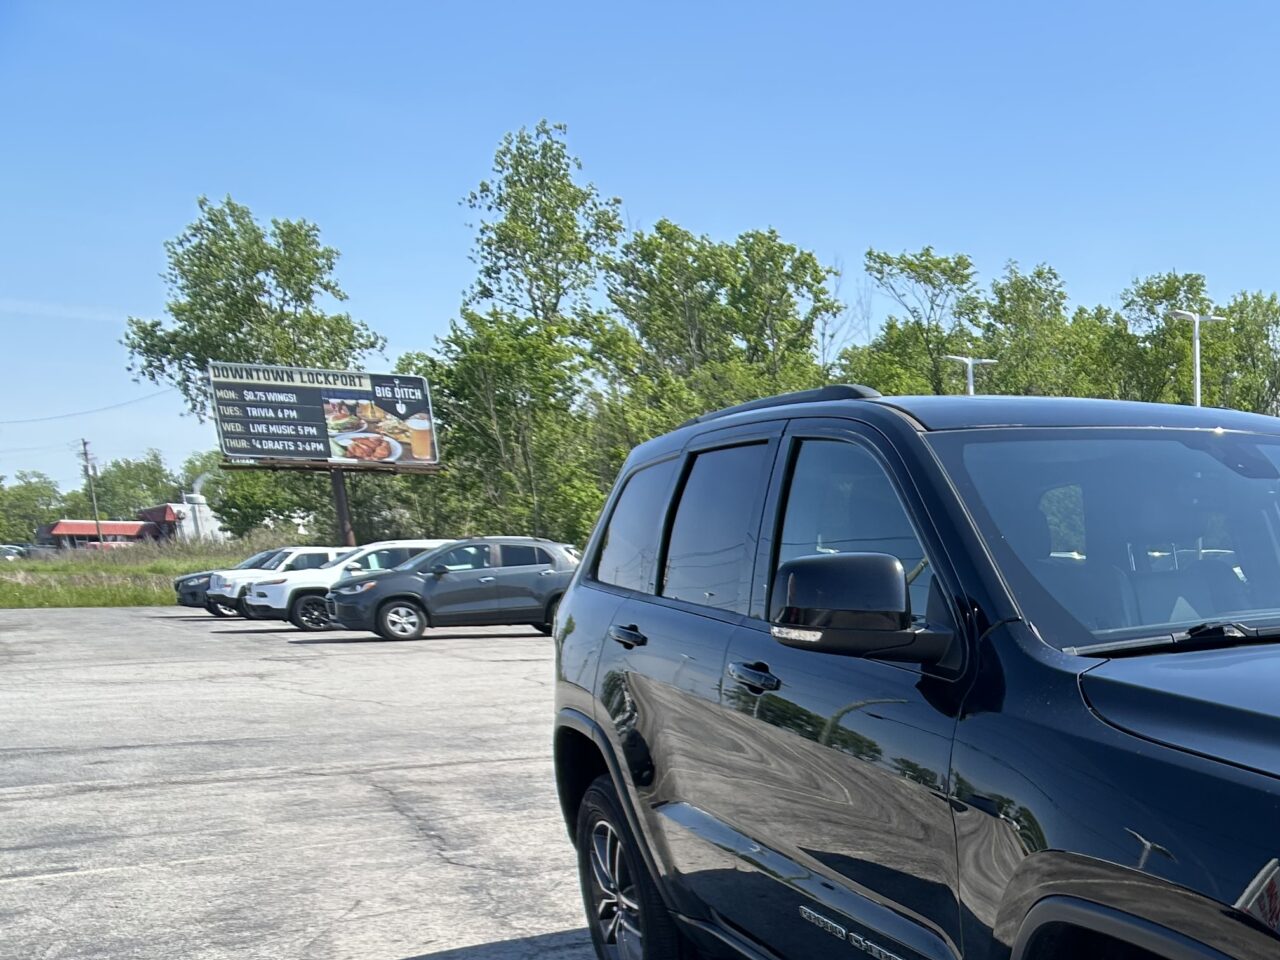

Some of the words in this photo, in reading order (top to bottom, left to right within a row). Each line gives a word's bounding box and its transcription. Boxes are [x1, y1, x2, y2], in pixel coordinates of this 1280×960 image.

[212, 365, 295, 383] DOWNTOWN
[299, 370, 364, 387] LOCKPORT
[215, 389, 239, 400] MON:
[243, 390, 266, 401] $0.75
[266, 391, 297, 403] WINGS!
[374, 386, 392, 397] BIG
[394, 387, 422, 400] DITCH
[218, 405, 243, 416] TUES:
[246, 407, 275, 418] TRIVIA
[277, 408, 283, 418] 6
[284, 409, 298, 419] PM
[221, 422, 245, 432] WED:
[249, 423, 268, 433] LIVE
[269, 424, 296, 435] MUSIC
[297, 426, 304, 435] 5
[305, 426, 318, 436] PM
[224, 438, 250, 449] THUR:
[263, 440, 295, 450] DRAFTS
[297, 441, 311, 451] 3-6
[311, 442, 324, 452] PM
